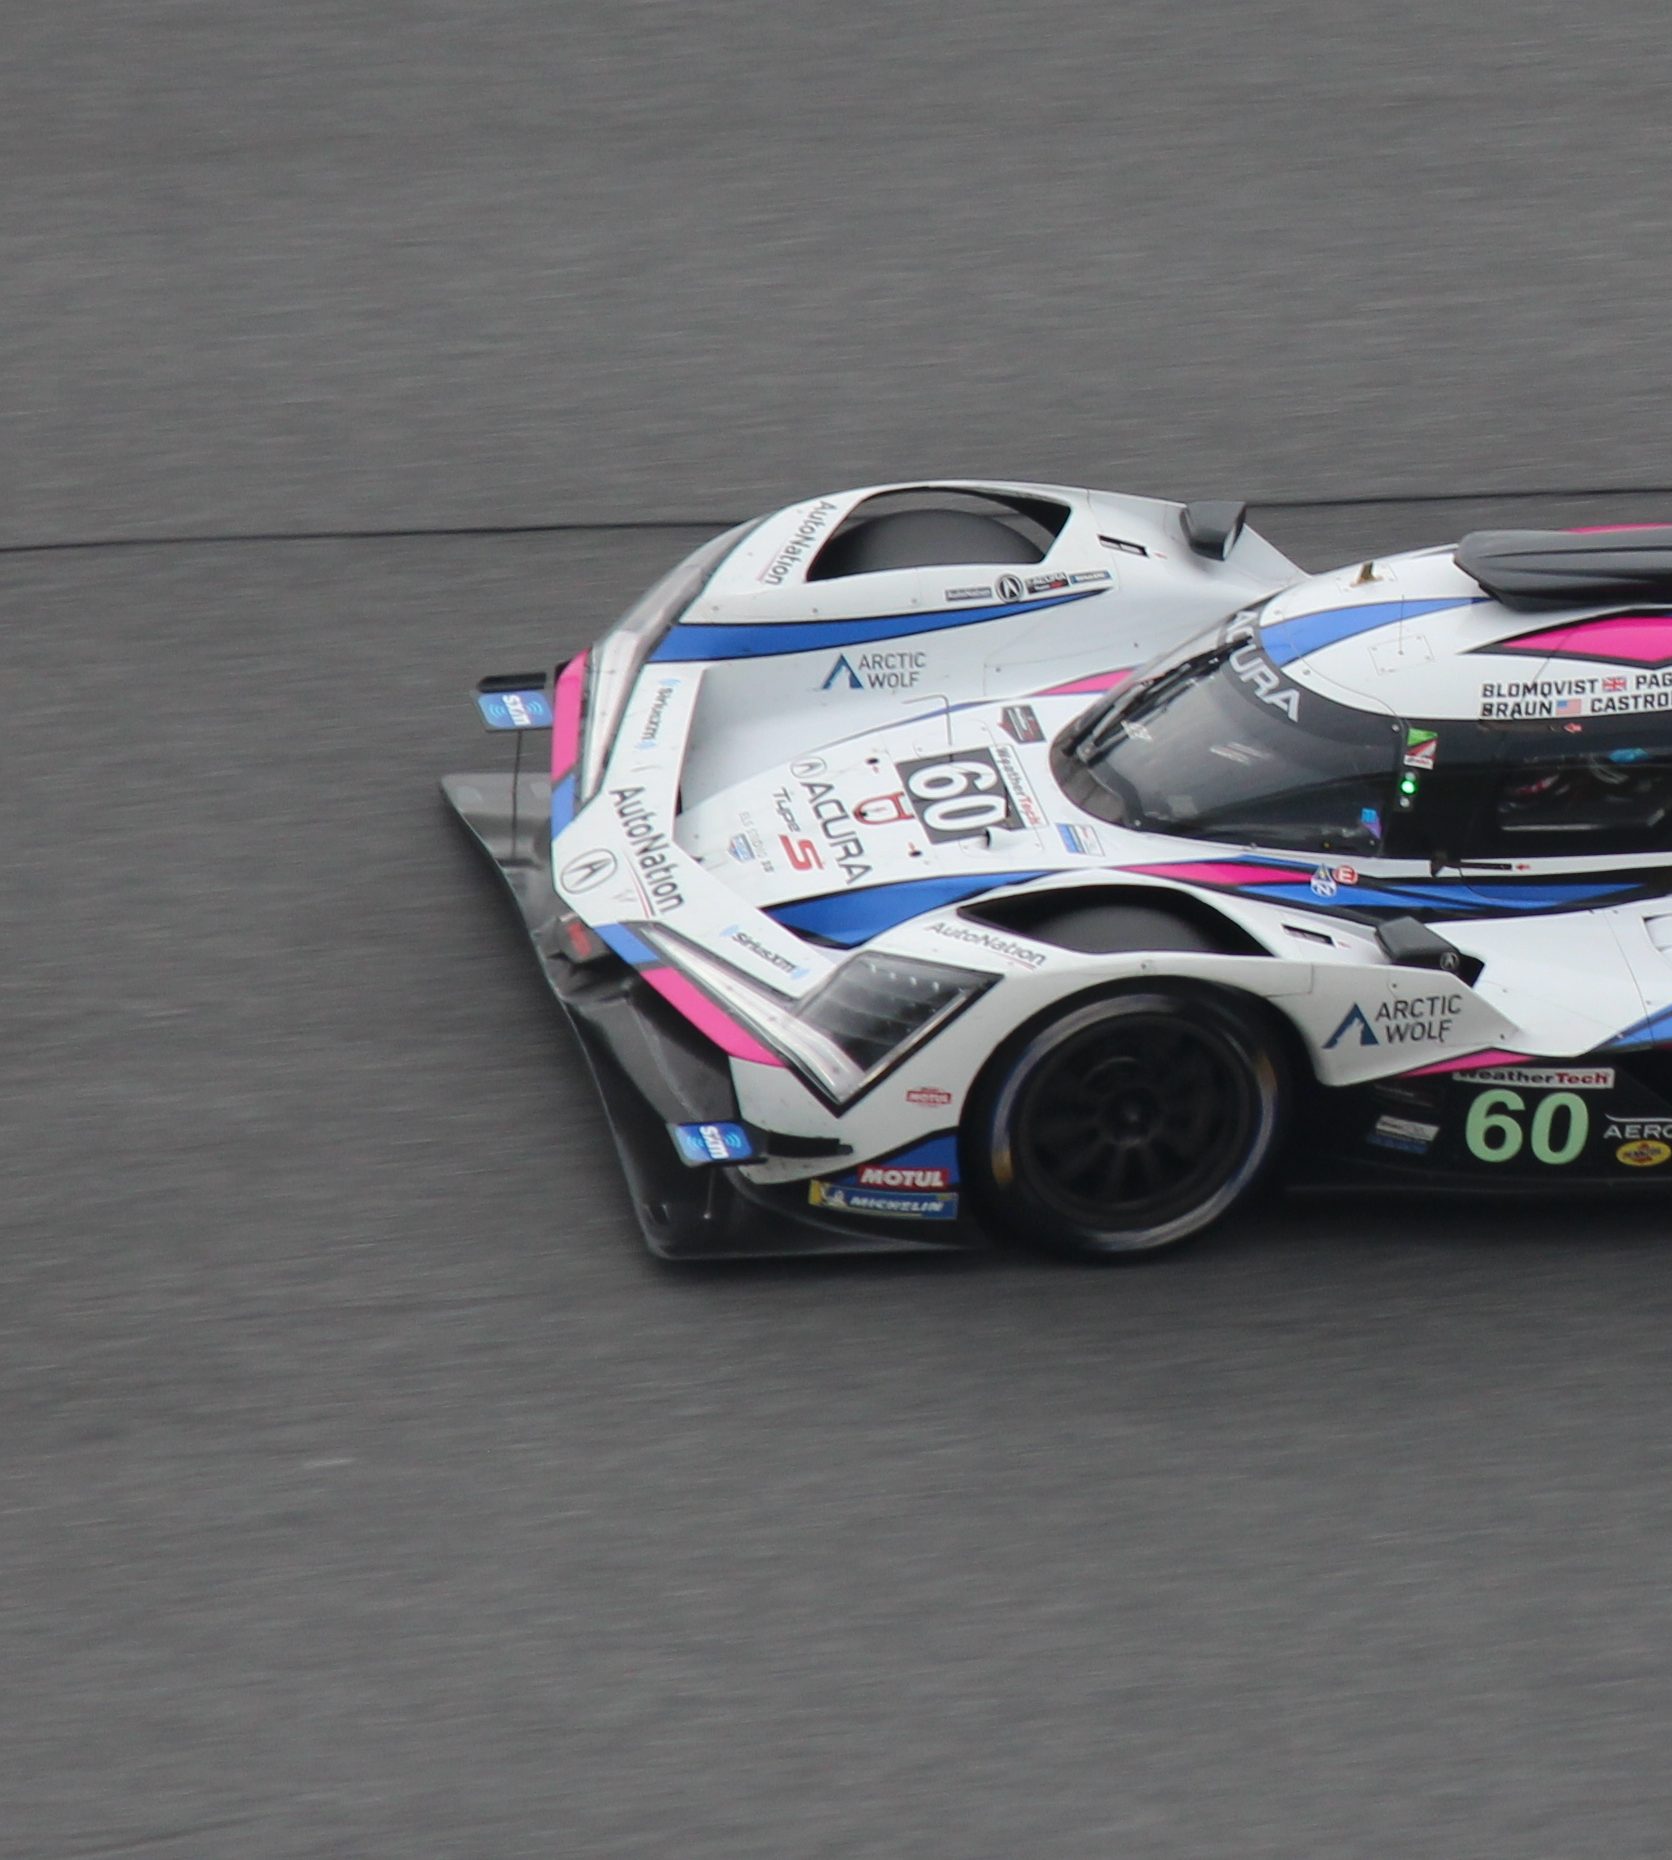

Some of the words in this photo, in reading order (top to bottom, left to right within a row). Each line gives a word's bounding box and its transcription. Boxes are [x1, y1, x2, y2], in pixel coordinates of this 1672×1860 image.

[765, 500, 837, 586] AutoNation
[858, 651, 926, 670] ARCTIC
[867, 671, 920, 689] WOLF
[1481, 678, 1599, 699] BLOMQVIST
[1481, 701, 1553, 718] BRAUN
[772, 787, 801, 832] Type
[908, 761, 1007, 831] 60
[800, 781, 874, 885] ACURA
[609, 787, 685, 913] AutoNation
[778, 834, 826, 871] S
[924, 921, 1047, 966] AutoNation
[1375, 994, 1463, 1021] ARCTIC
[1385, 1019, 1454, 1044] WOLF
[1458, 1068, 1609, 1085] WeatherTech
[1465, 1088, 1590, 1165] 60
[860, 1168, 944, 1187] MOTUL
[850, 1196, 944, 1213] MICHELIN
